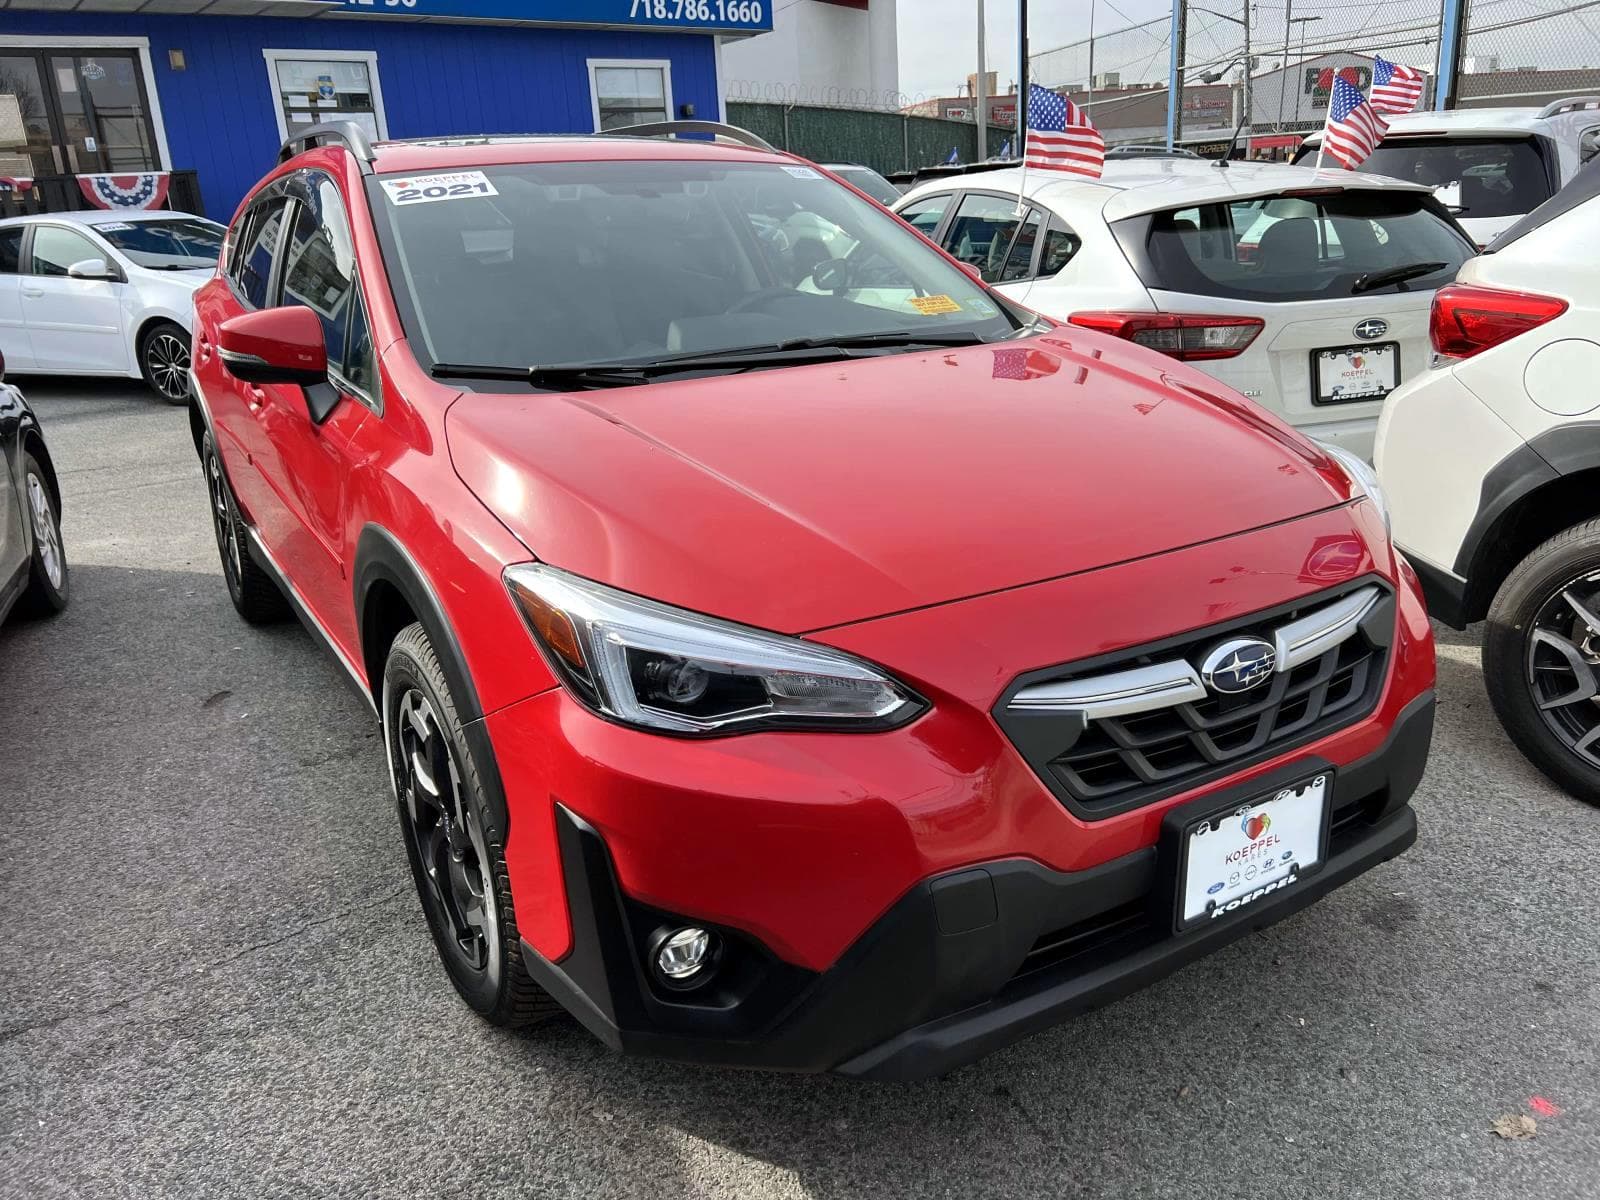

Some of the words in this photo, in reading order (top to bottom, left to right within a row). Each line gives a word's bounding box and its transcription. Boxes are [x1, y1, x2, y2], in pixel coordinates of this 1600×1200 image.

[629, 0, 762, 23] 718.786.1660
[396, 182, 489, 203] 2021
[1225, 833, 1281, 865] KOEPPEL
[1211, 873, 1297, 918] KOEPPEL
